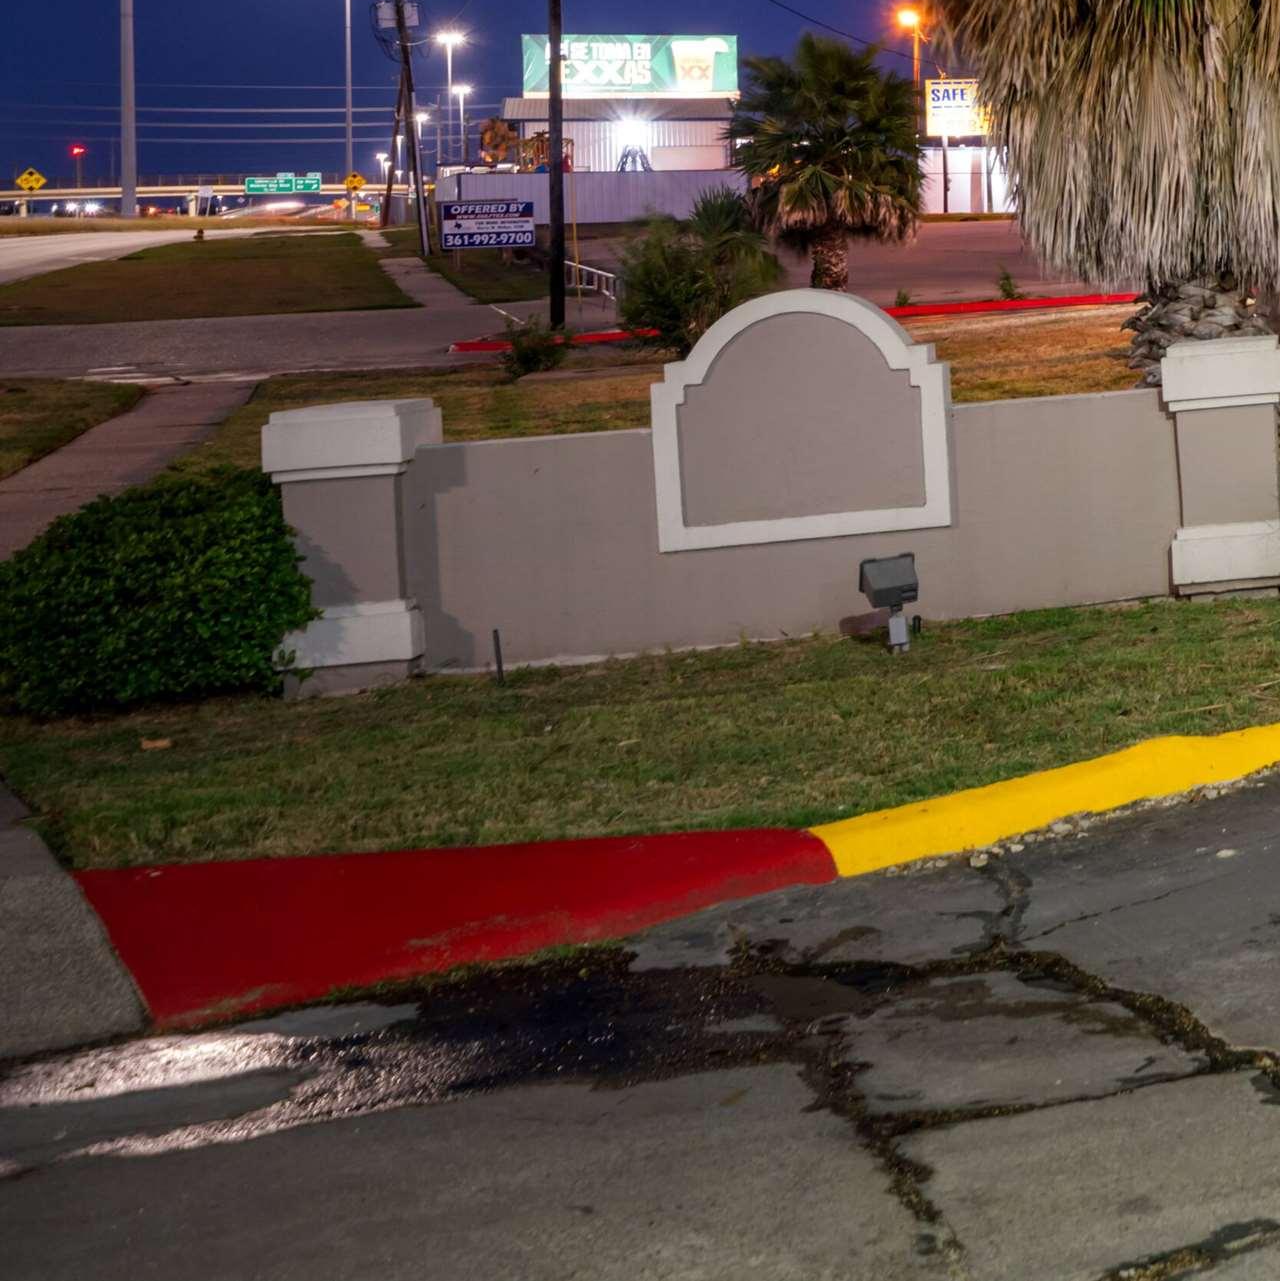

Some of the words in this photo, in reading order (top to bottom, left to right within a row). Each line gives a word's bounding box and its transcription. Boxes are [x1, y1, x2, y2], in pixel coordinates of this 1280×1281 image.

[546, 60, 652, 84] EXXAS
[931, 88, 969, 102] SAFE
[450, 204, 508, 214] OFFERED
[509, 202, 526, 212] BY
[446, 232, 532, 246] 361-992-9700
